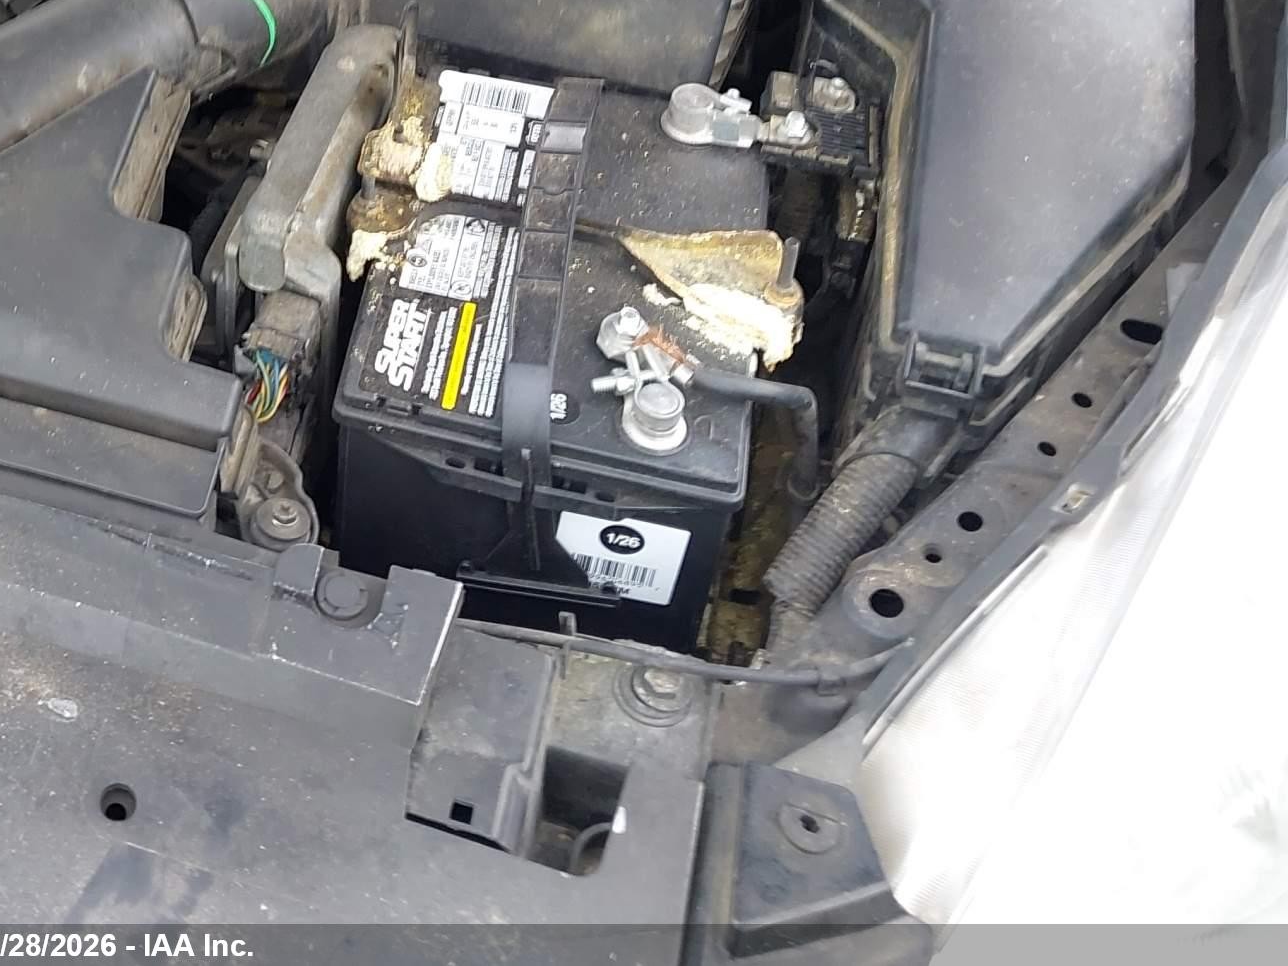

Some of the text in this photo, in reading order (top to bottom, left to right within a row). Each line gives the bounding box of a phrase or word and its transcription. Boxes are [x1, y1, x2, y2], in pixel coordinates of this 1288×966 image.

[374, 298, 410, 374] SUPER
[387, 301, 427, 392] START
[550, 393, 568, 420] 1/26
[605, 532, 641, 549] 1/26
